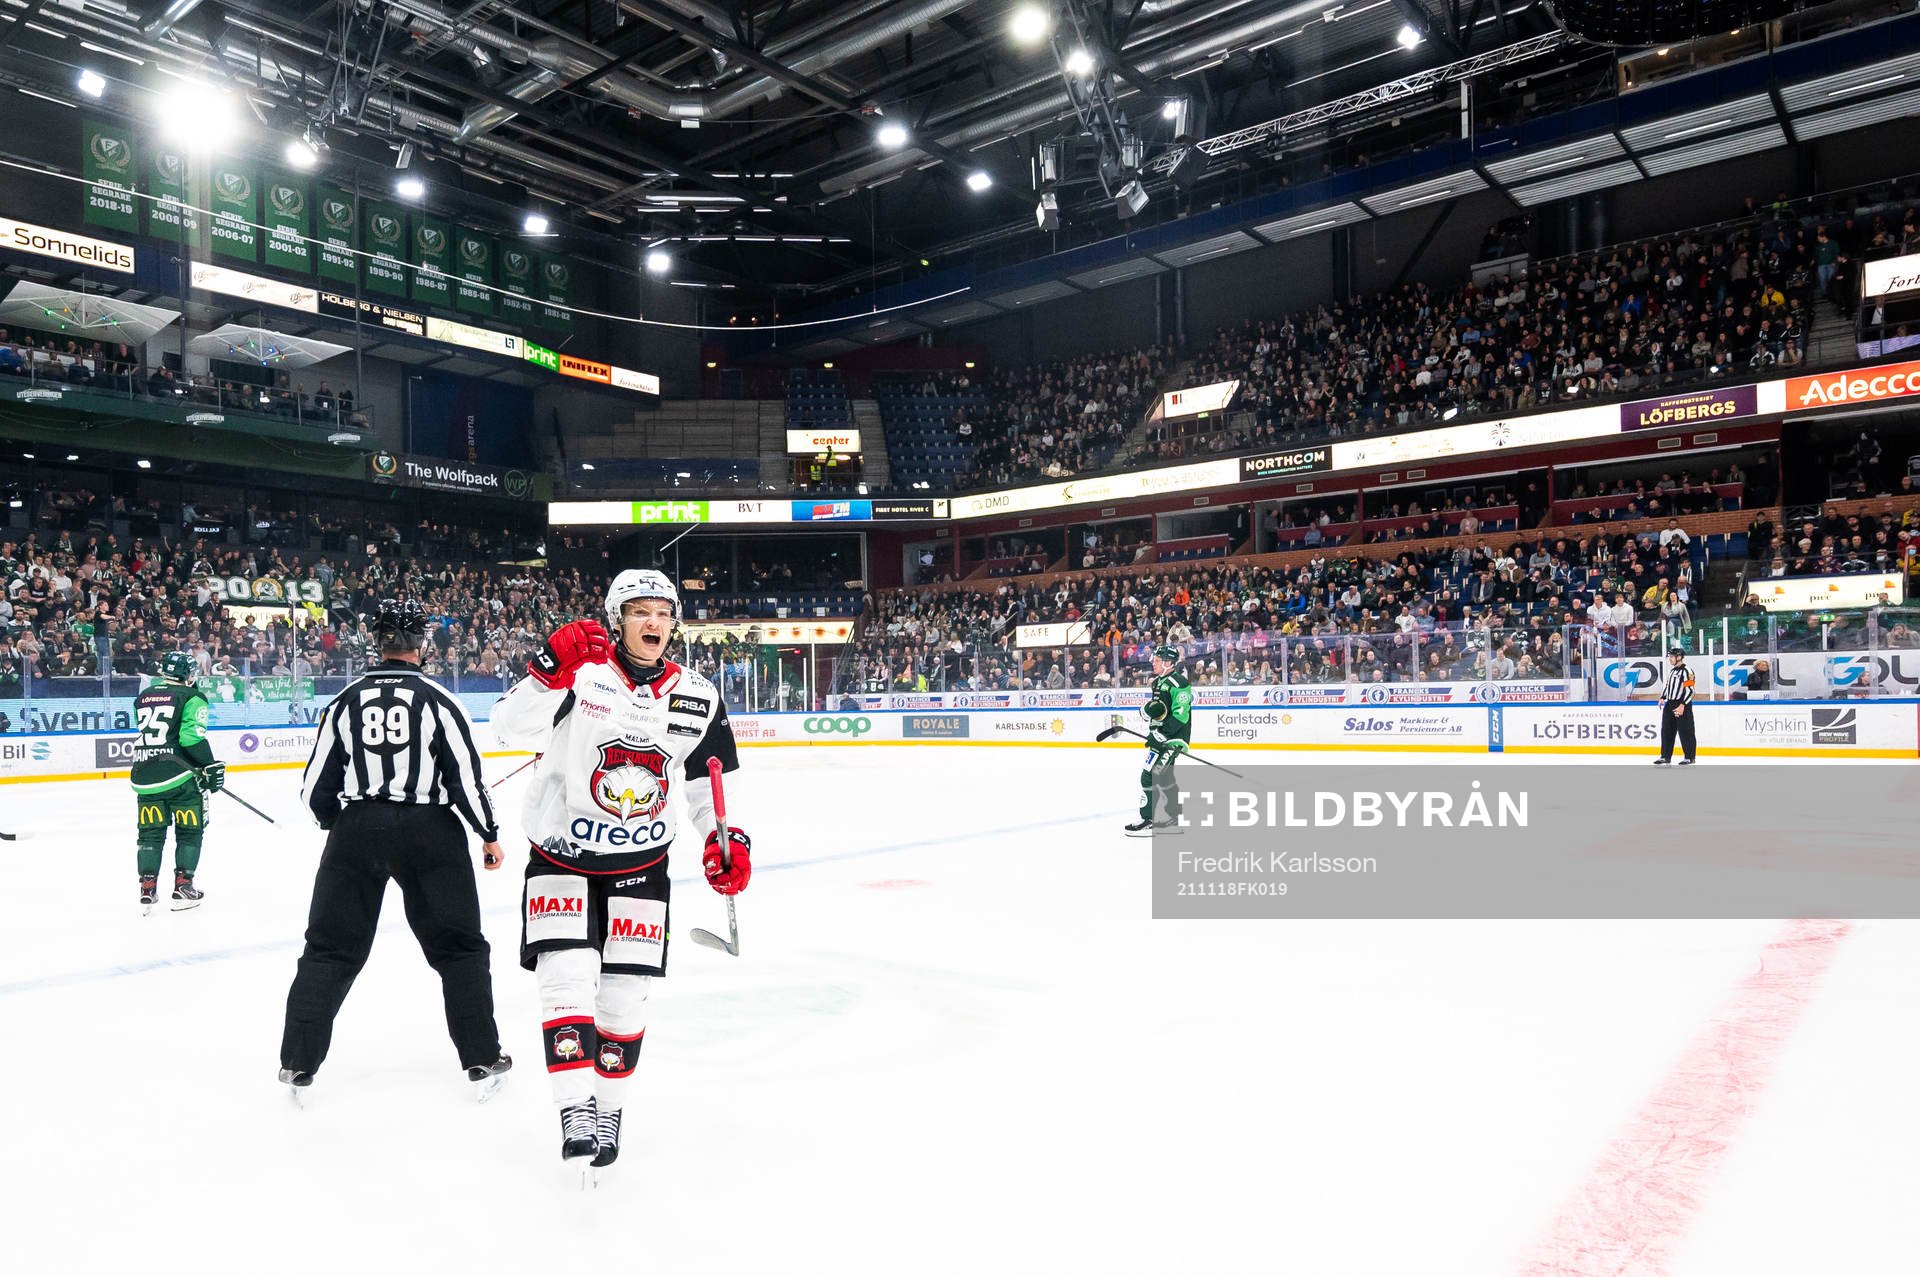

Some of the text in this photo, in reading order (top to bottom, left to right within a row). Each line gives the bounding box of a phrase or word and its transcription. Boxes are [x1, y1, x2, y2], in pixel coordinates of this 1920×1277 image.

[90, 196, 133, 214] 2018-19
[212, 227, 254, 245] 2006-07
[14, 227, 131, 267] Sonnelids
[270, 240, 307, 257] 2001-02
[322, 252, 355, 268] 1991-92
[370, 266, 404, 281] 1989-90
[416, 277, 447, 291] 1986-87
[383, 308, 423, 323] NIELSEN
[562, 359, 608, 377] UNIFLEX
[1640, 401, 1736, 426] LÖFBERGS
[813, 436, 850, 445] center
[1245, 451, 1325, 472] NORTHCOM
[404, 462, 432, 479] The
[436, 466, 498, 488] Wolfpack
[641, 502, 700, 522] print
[738, 502, 764, 513] BVT
[679, 700, 707, 713] RSA
[134, 705, 176, 746] 25
[362, 705, 410, 746] 89
[803, 717, 872, 737] coop
[912, 718, 960, 729] ROYALE
[995, 722, 1047, 731] KARLSTAD.SE
[1217, 713, 1278, 725] Karlstads
[1343, 717, 1394, 732] Salos
[1745, 717, 1807, 736] Myshkin
[1218, 727, 1257, 740] Energi
[1400, 725, 1463, 734] Persienner AB
[1533, 720, 1658, 740] LÖFBERGS
[264, 737, 295, 748] Grant
[3, 744, 25, 759] Bil
[606, 747, 664, 774] REDHAWKS
[571, 817, 666, 846] areco
[615, 876, 646, 888] CCM
[529, 896, 583, 916] MAXI
[612, 918, 663, 941] MAXI
